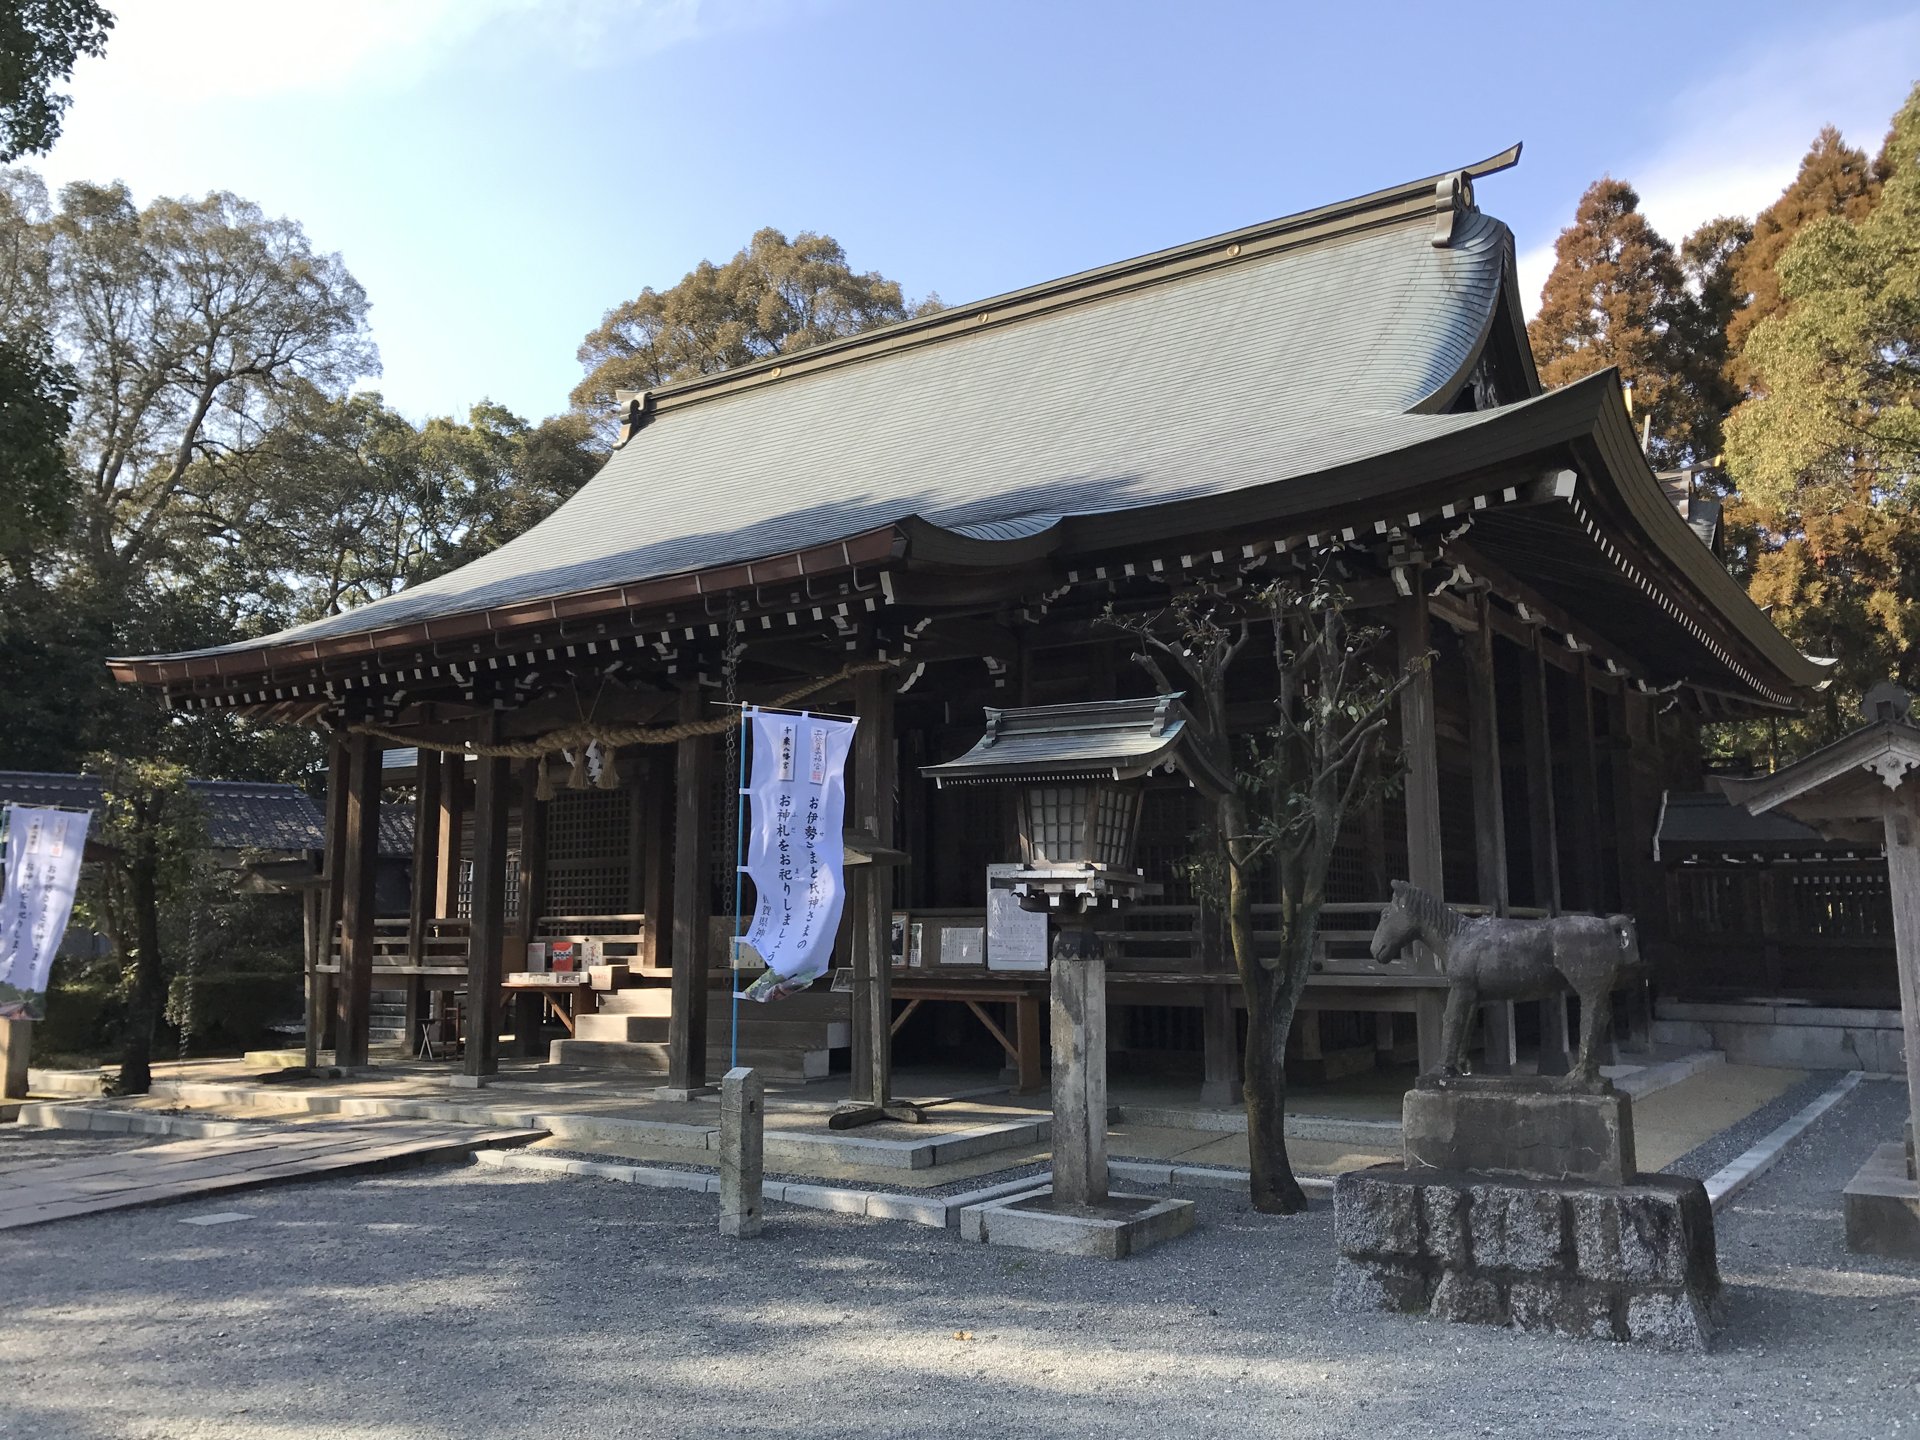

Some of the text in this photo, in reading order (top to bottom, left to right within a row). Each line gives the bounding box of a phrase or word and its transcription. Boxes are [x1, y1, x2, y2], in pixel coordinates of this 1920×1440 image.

[767, 794, 793, 962] お神札をお祀りしましょう
[797, 796, 819, 950] お伊勢さまと氏神さまの
